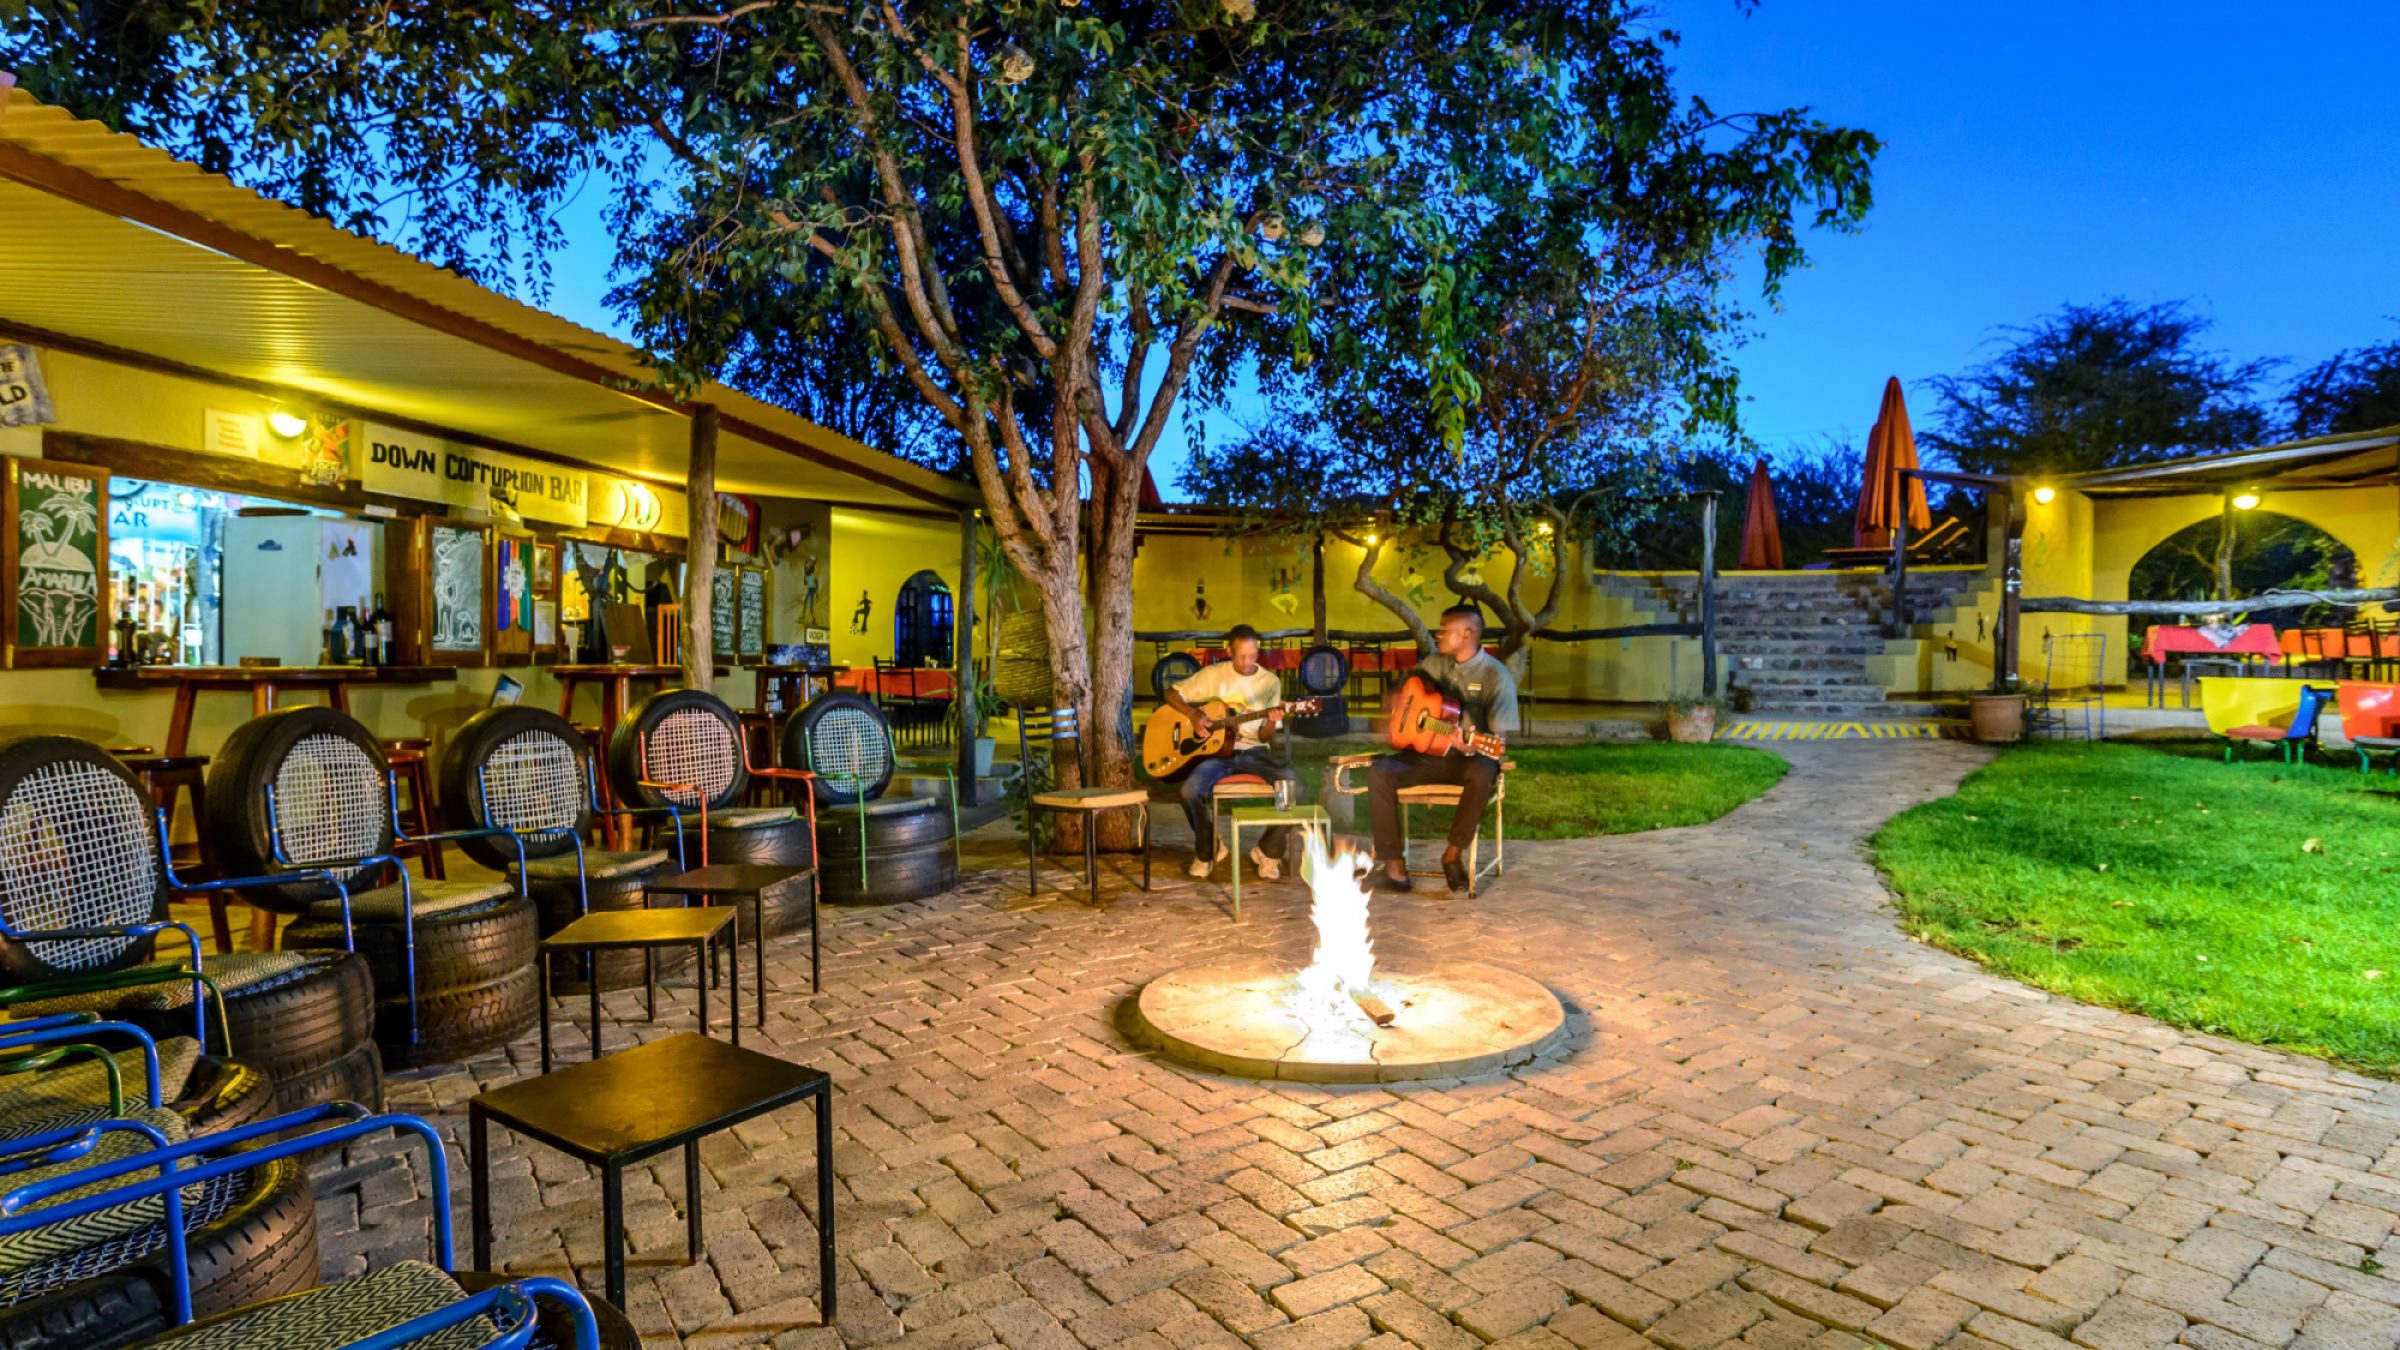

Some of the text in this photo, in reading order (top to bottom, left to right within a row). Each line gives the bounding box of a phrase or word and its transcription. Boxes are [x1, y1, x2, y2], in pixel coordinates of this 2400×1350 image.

[23, 471, 93, 493] MALIBU
[371, 442, 436, 474] DOWN
[550, 475, 583, 505] BAR
[19, 567, 98, 597] AMARULA
